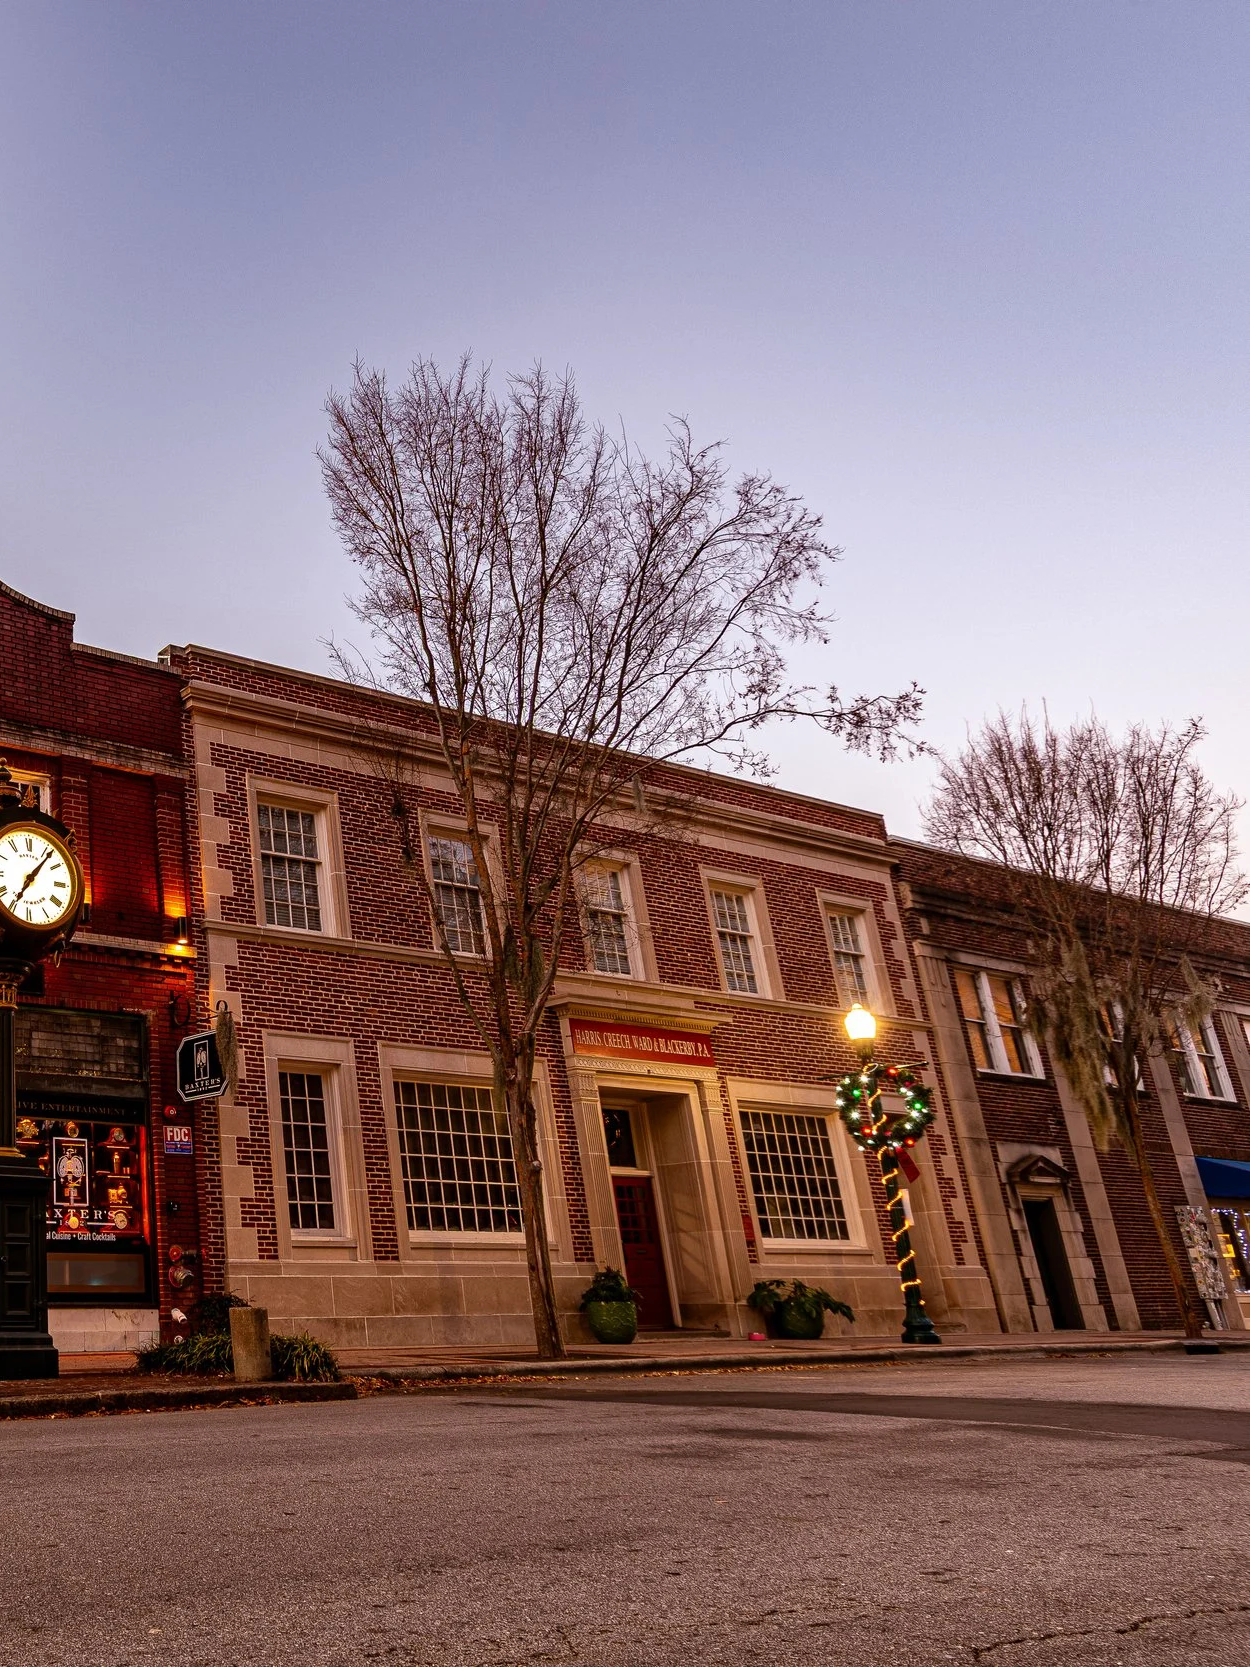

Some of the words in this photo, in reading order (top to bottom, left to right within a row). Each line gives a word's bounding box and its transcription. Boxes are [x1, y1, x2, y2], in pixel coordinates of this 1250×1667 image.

[632, 1036, 653, 1051] WARD
[653, 1039, 659, 1052] &
[185, 1077, 221, 1091] BAXTER'S
[17, 1101, 38, 1110] IVE
[41, 1103, 126, 1116] ENTERTAINMENT
[166, 1127, 189, 1142] FDC
[52, 1231, 71, 1240] Cuisine
[77, 1231, 92, 1240] Craft
[92, 1232, 117, 1241] Cocktails
